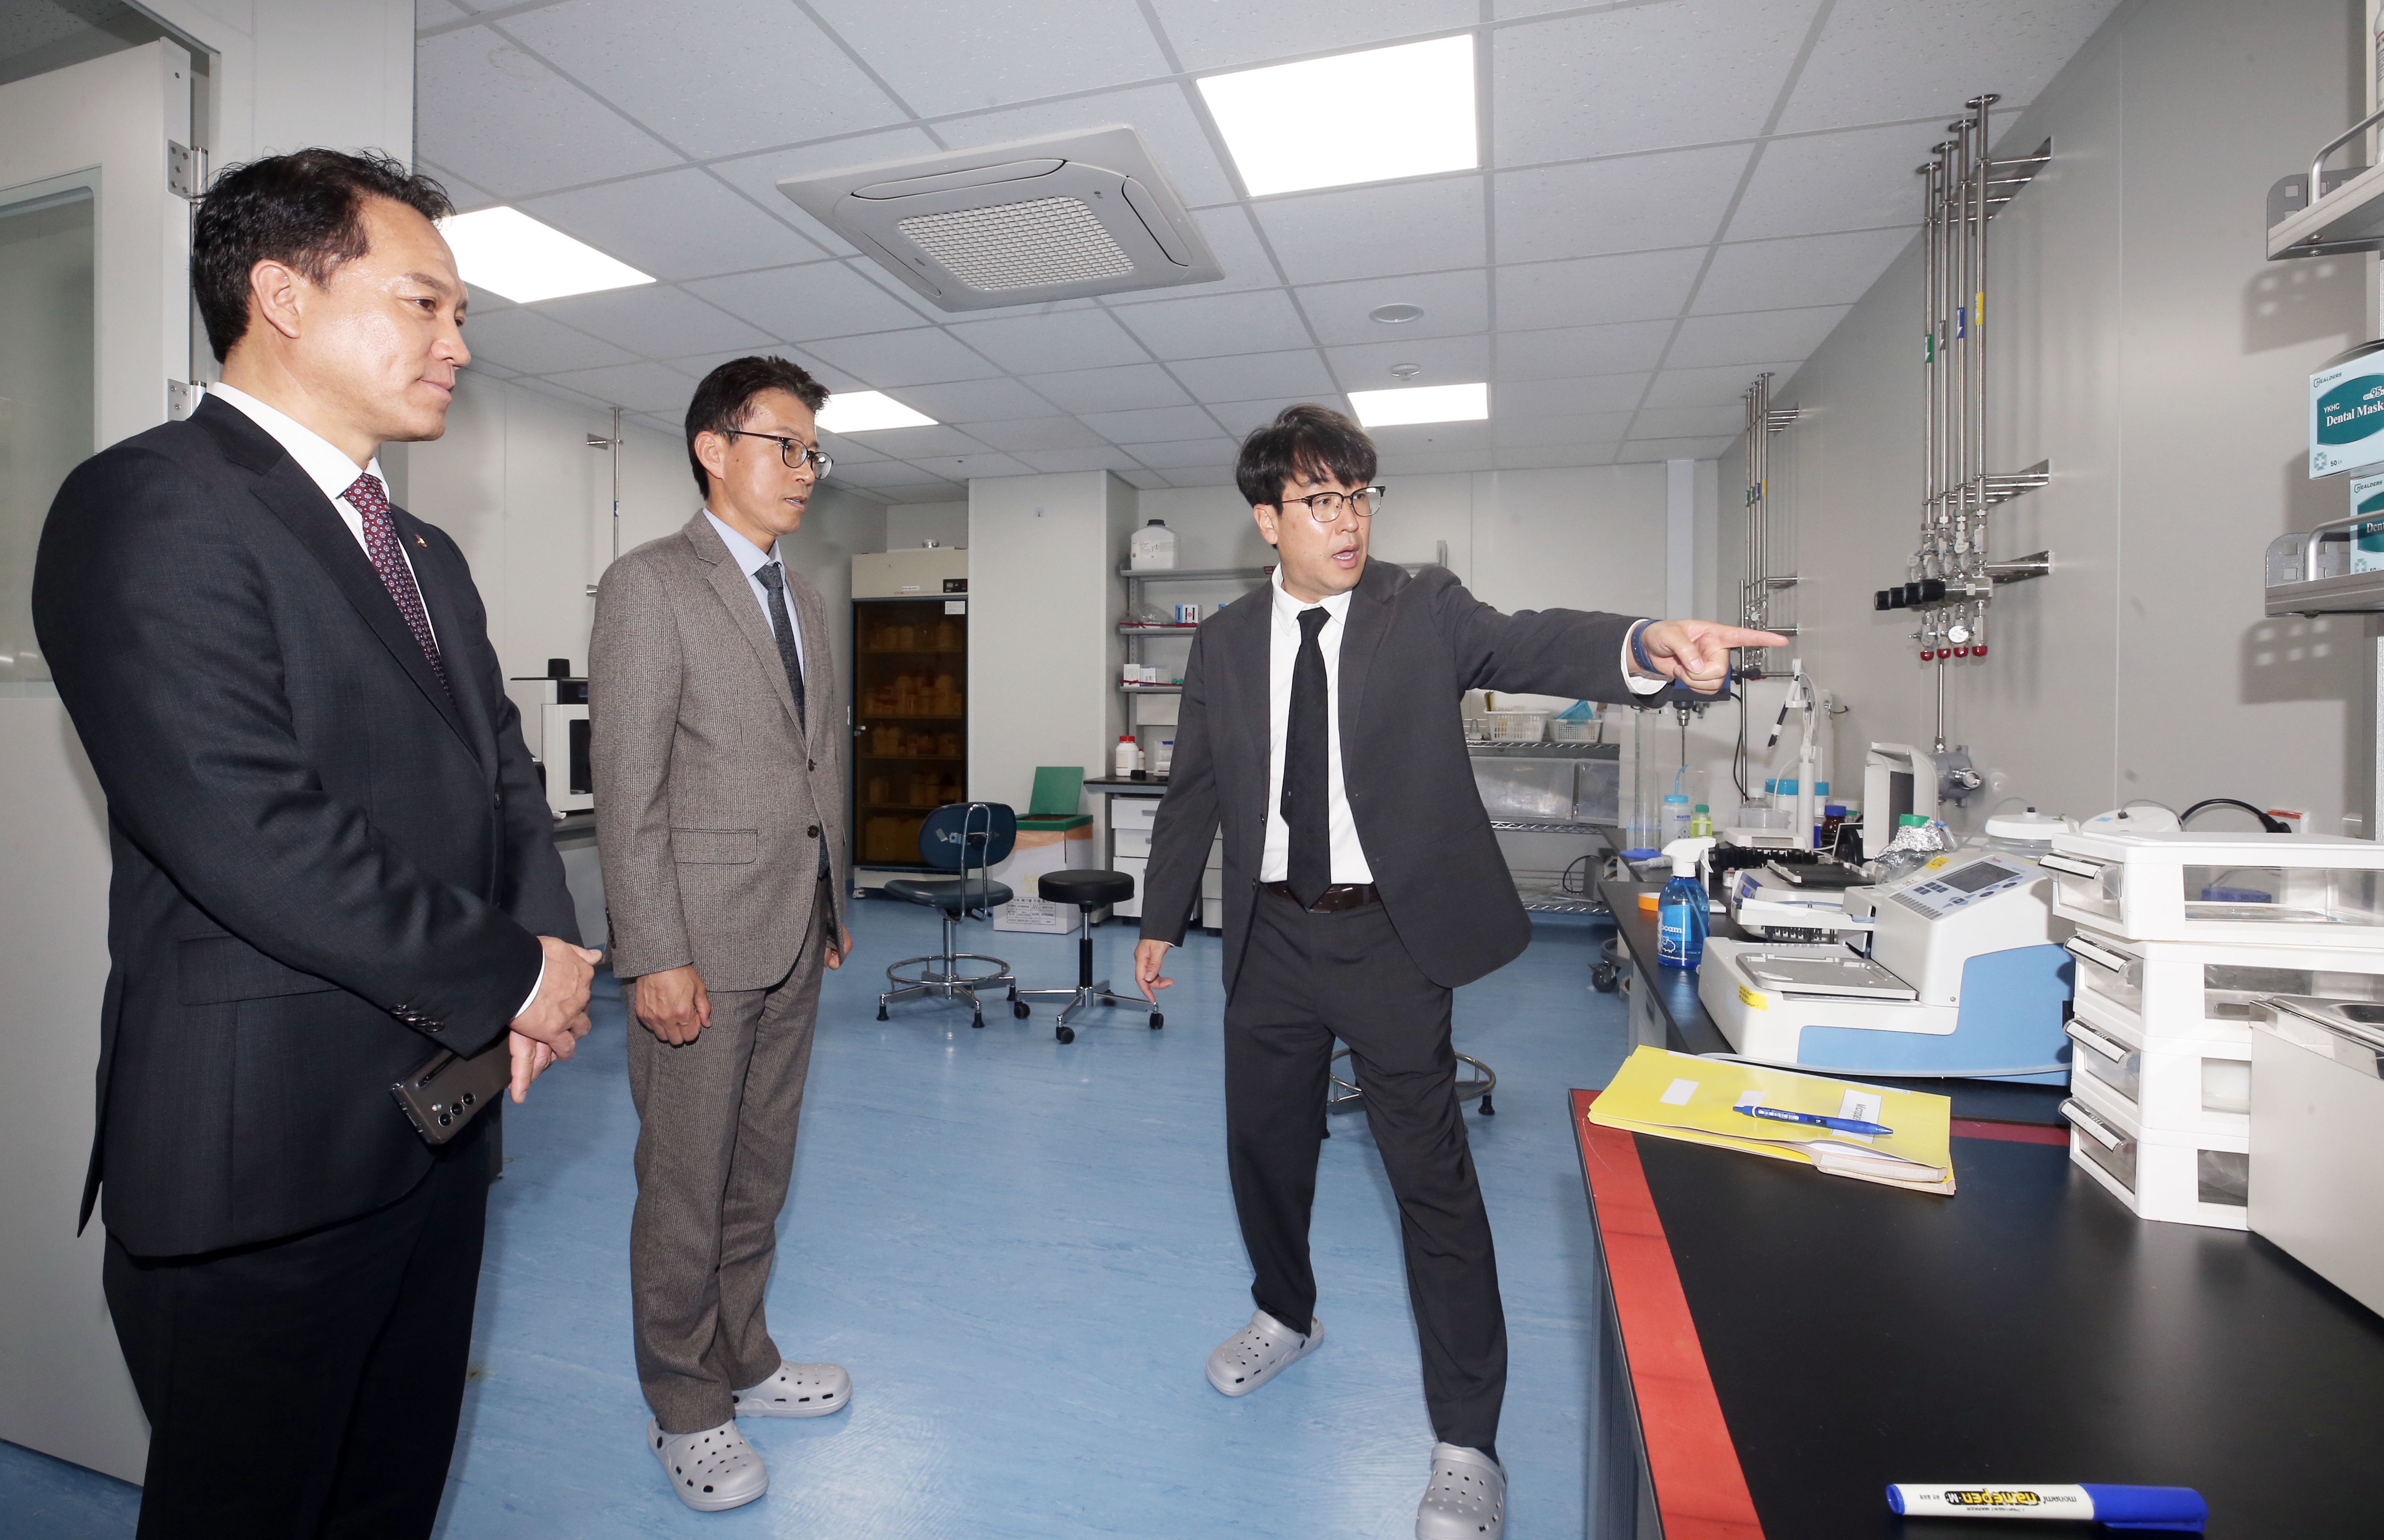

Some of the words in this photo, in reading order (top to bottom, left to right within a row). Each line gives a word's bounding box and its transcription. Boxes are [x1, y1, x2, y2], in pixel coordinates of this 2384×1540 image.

[2315, 372, 2342, 386] HEALDERS
[2324, 403, 2340, 414] YKHC
[2326, 408, 2355, 427] Dental
[2357, 400, 2384, 418] Mask
[2355, 480, 2383, 493] HEALDERS
[2088, 1114, 2104, 1125] INDEX
